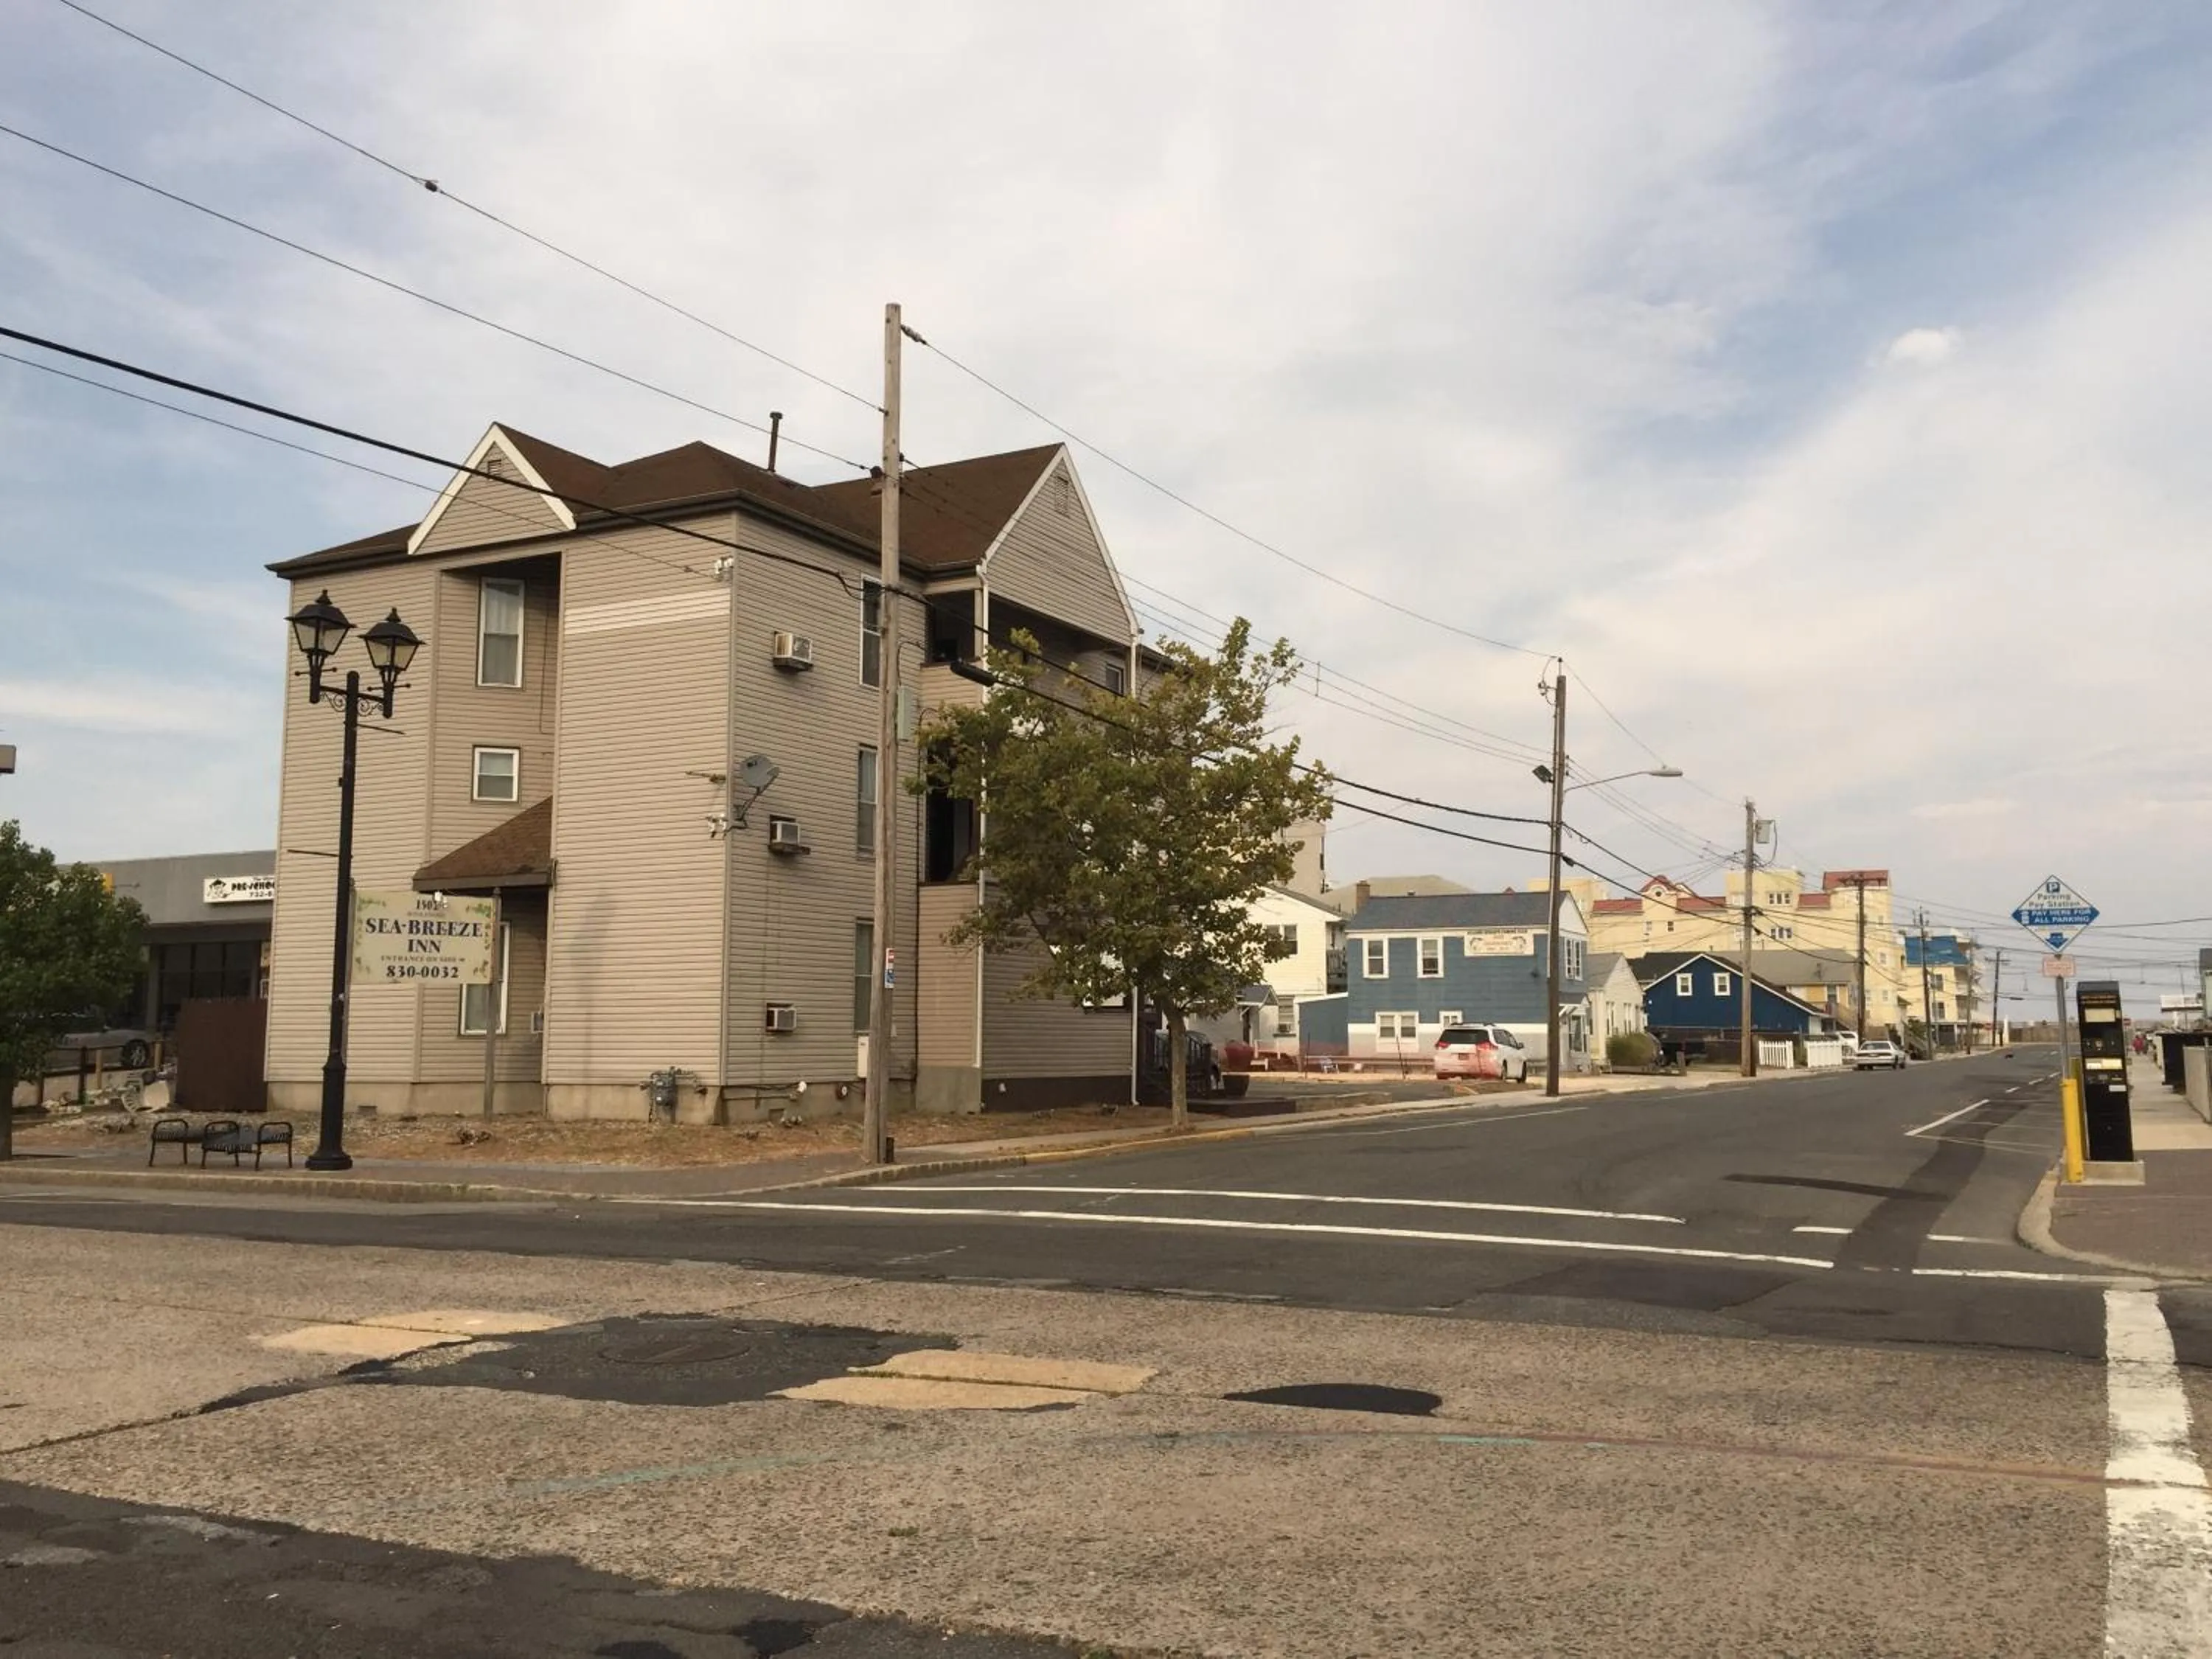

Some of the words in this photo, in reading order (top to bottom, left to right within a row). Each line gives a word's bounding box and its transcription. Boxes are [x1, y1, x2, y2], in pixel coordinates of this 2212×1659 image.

[2049, 883, 2058, 891] P
[407, 939, 442, 953] INN
[386, 964, 459, 979] 830-0032
